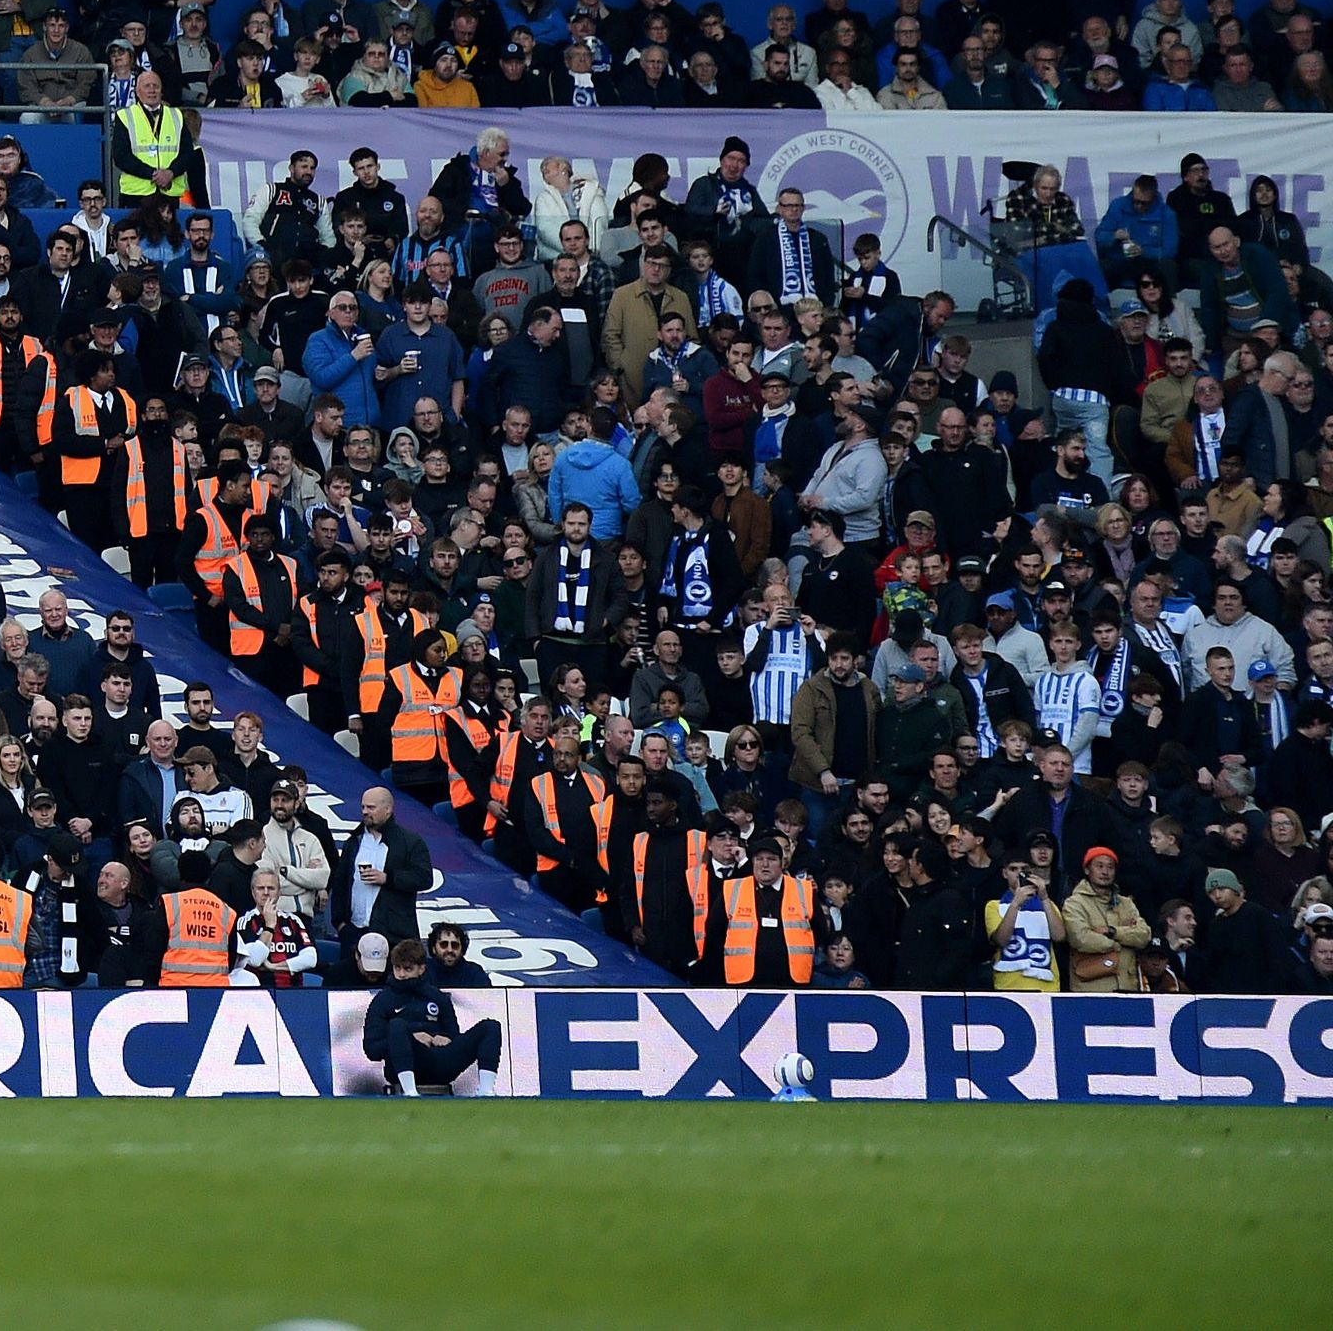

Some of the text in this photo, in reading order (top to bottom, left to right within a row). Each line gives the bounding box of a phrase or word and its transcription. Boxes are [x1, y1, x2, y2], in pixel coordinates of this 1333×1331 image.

[767, 134, 895, 182] SOUTH WEST CORNER
[276, 189, 293, 206] A
[486, 279, 529, 294] VIRGINIA
[494, 294, 519, 306] TECH
[183, 897, 221, 909] STEWARD
[186, 924, 217, 939] WISE
